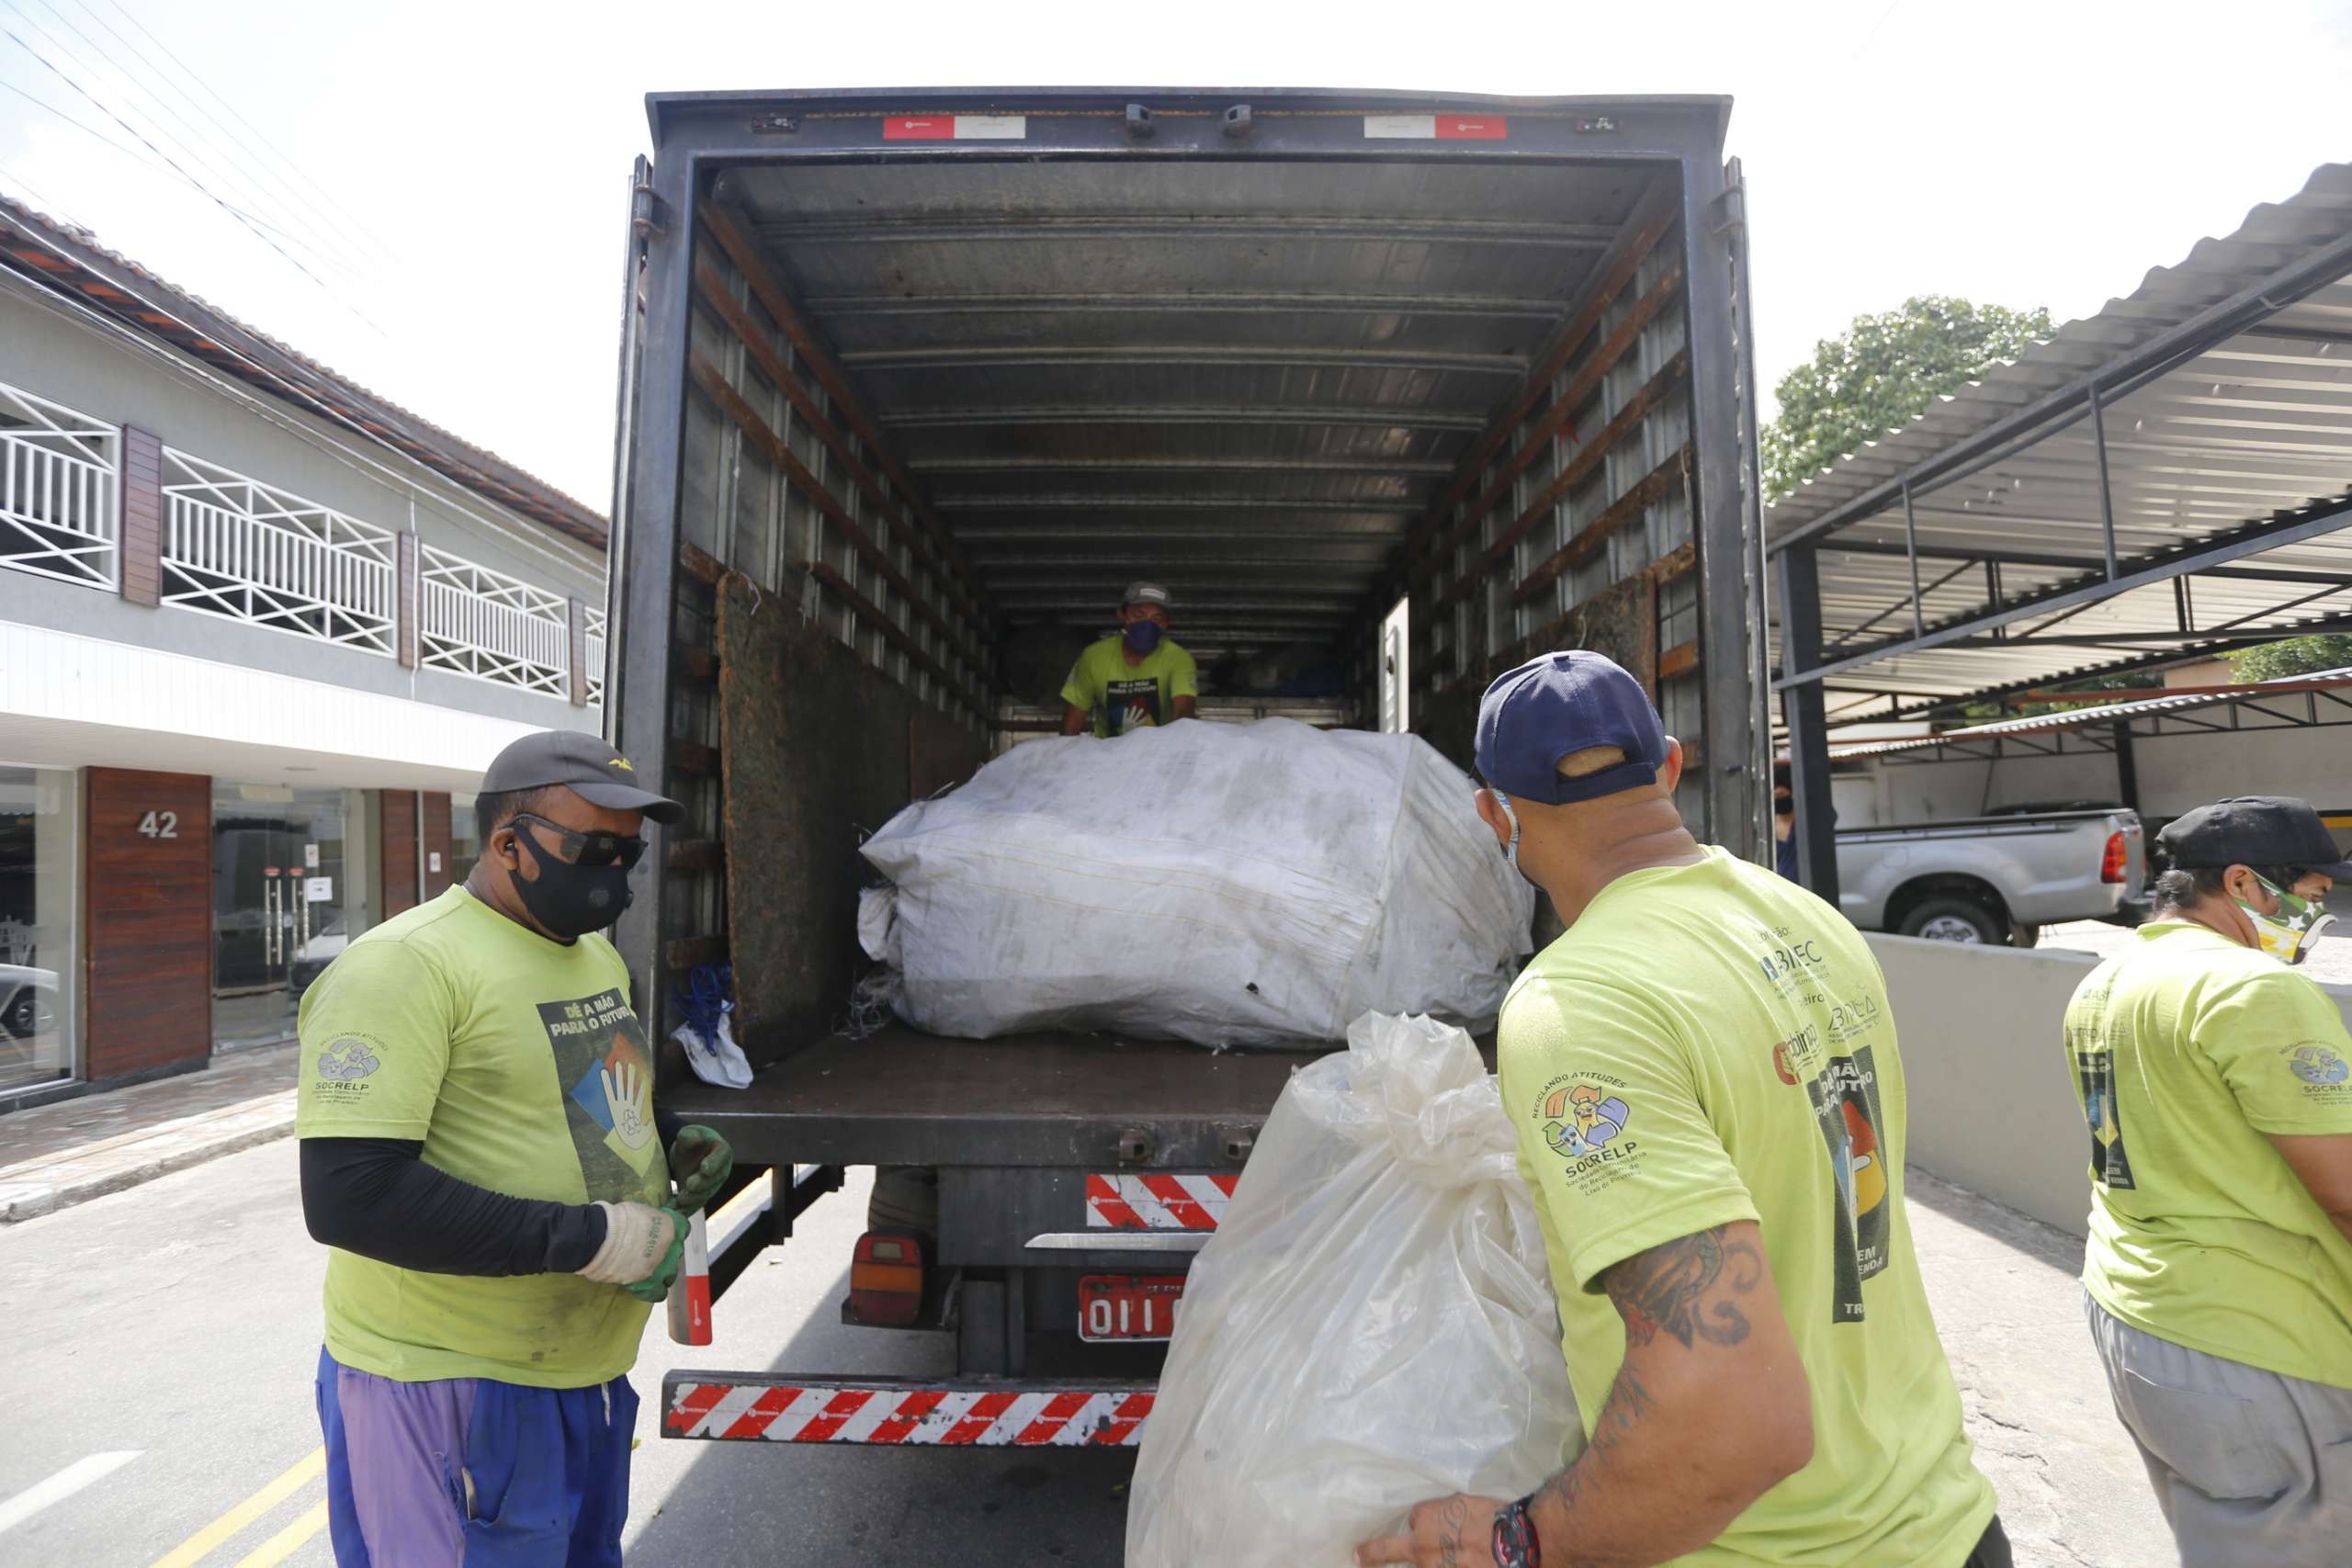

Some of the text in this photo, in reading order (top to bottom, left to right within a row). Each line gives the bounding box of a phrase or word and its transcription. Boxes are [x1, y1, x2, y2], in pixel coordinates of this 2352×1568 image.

[138, 810, 177, 838] 42
[564, 995, 615, 1019] DÊ A MÃO
[550, 1021, 588, 1036] PARA
[589, 1017, 599, 1029] O
[315, 1081, 369, 1090] SOCRELP
[1532, 1072, 1627, 1119] RECICLANDO ATITUDES
[1566, 1142, 1636, 1178] SOCRELP
